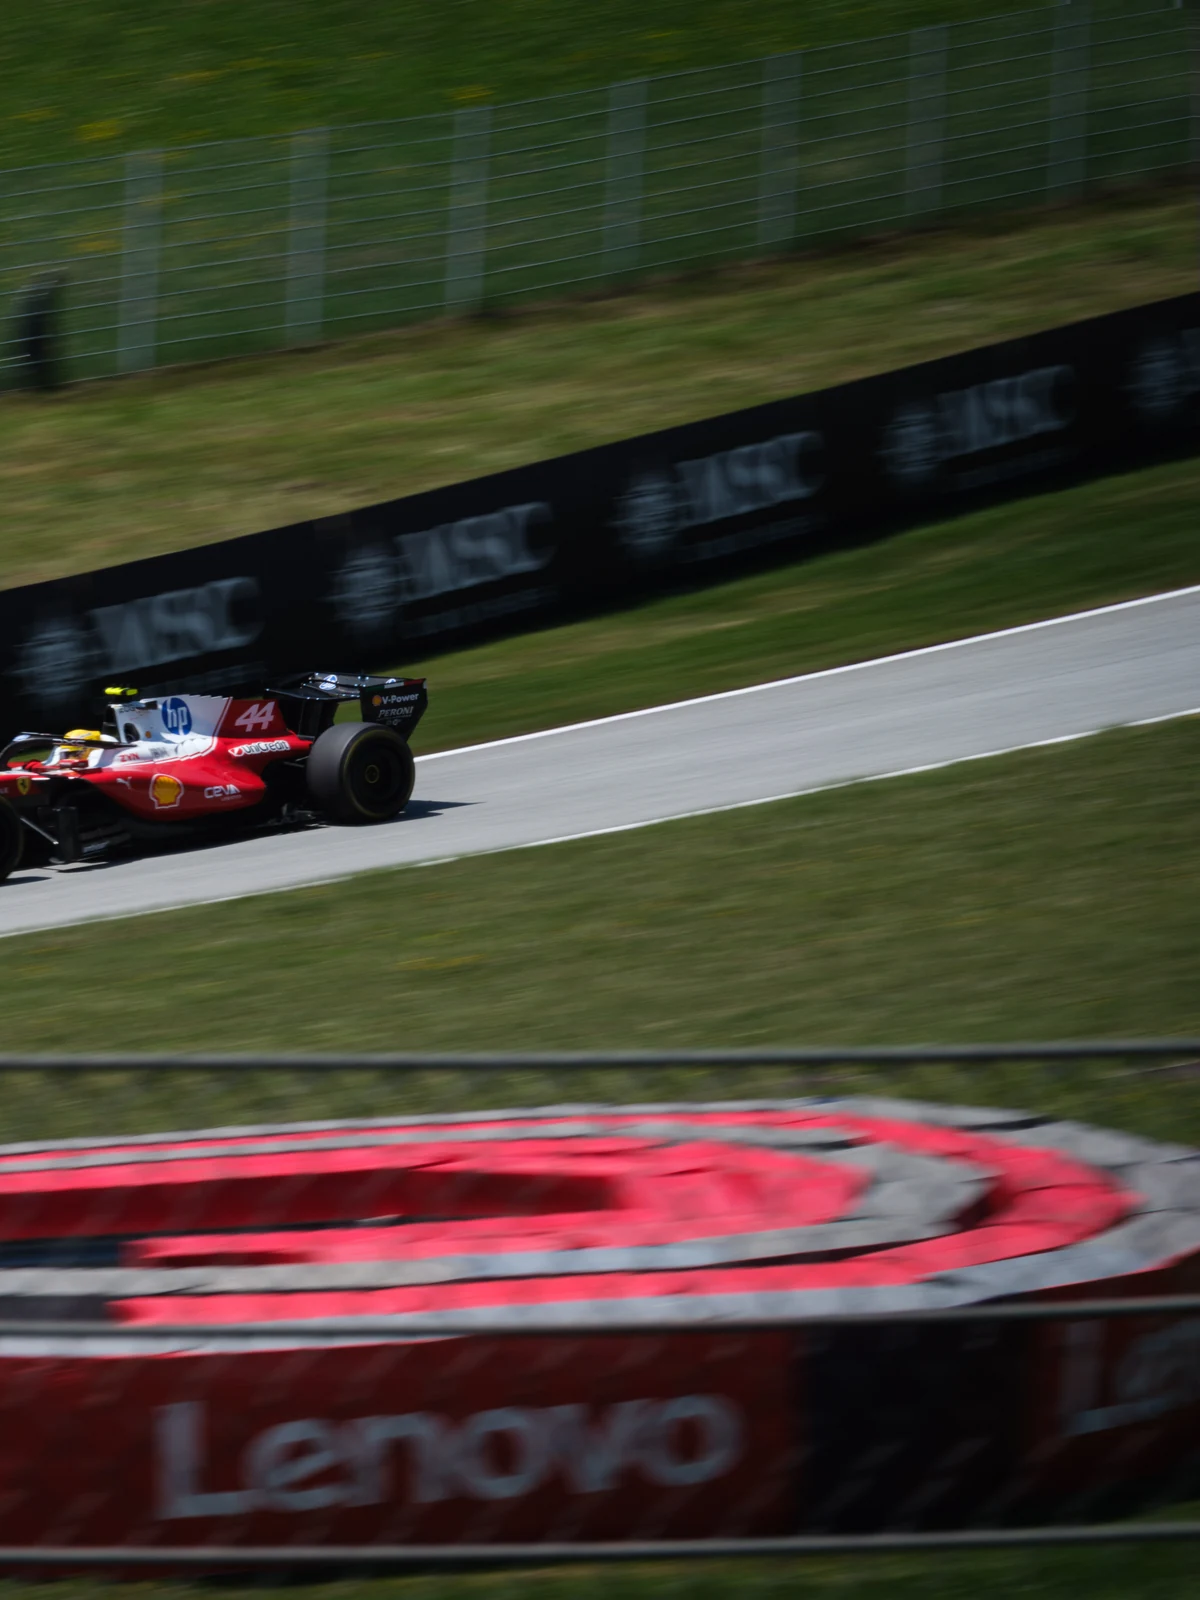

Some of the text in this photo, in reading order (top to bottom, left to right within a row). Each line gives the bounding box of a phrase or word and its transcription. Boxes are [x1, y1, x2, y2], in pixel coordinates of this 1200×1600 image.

[381, 693, 419, 705] V-Power
[163, 698, 191, 735] hp
[234, 701, 275, 732] 44
[378, 706, 414, 718] PERONI
[242, 740, 290, 754] UniCredit
[204, 784, 241, 799] CEVA
[156, 1394, 740, 1519] Lenovo
